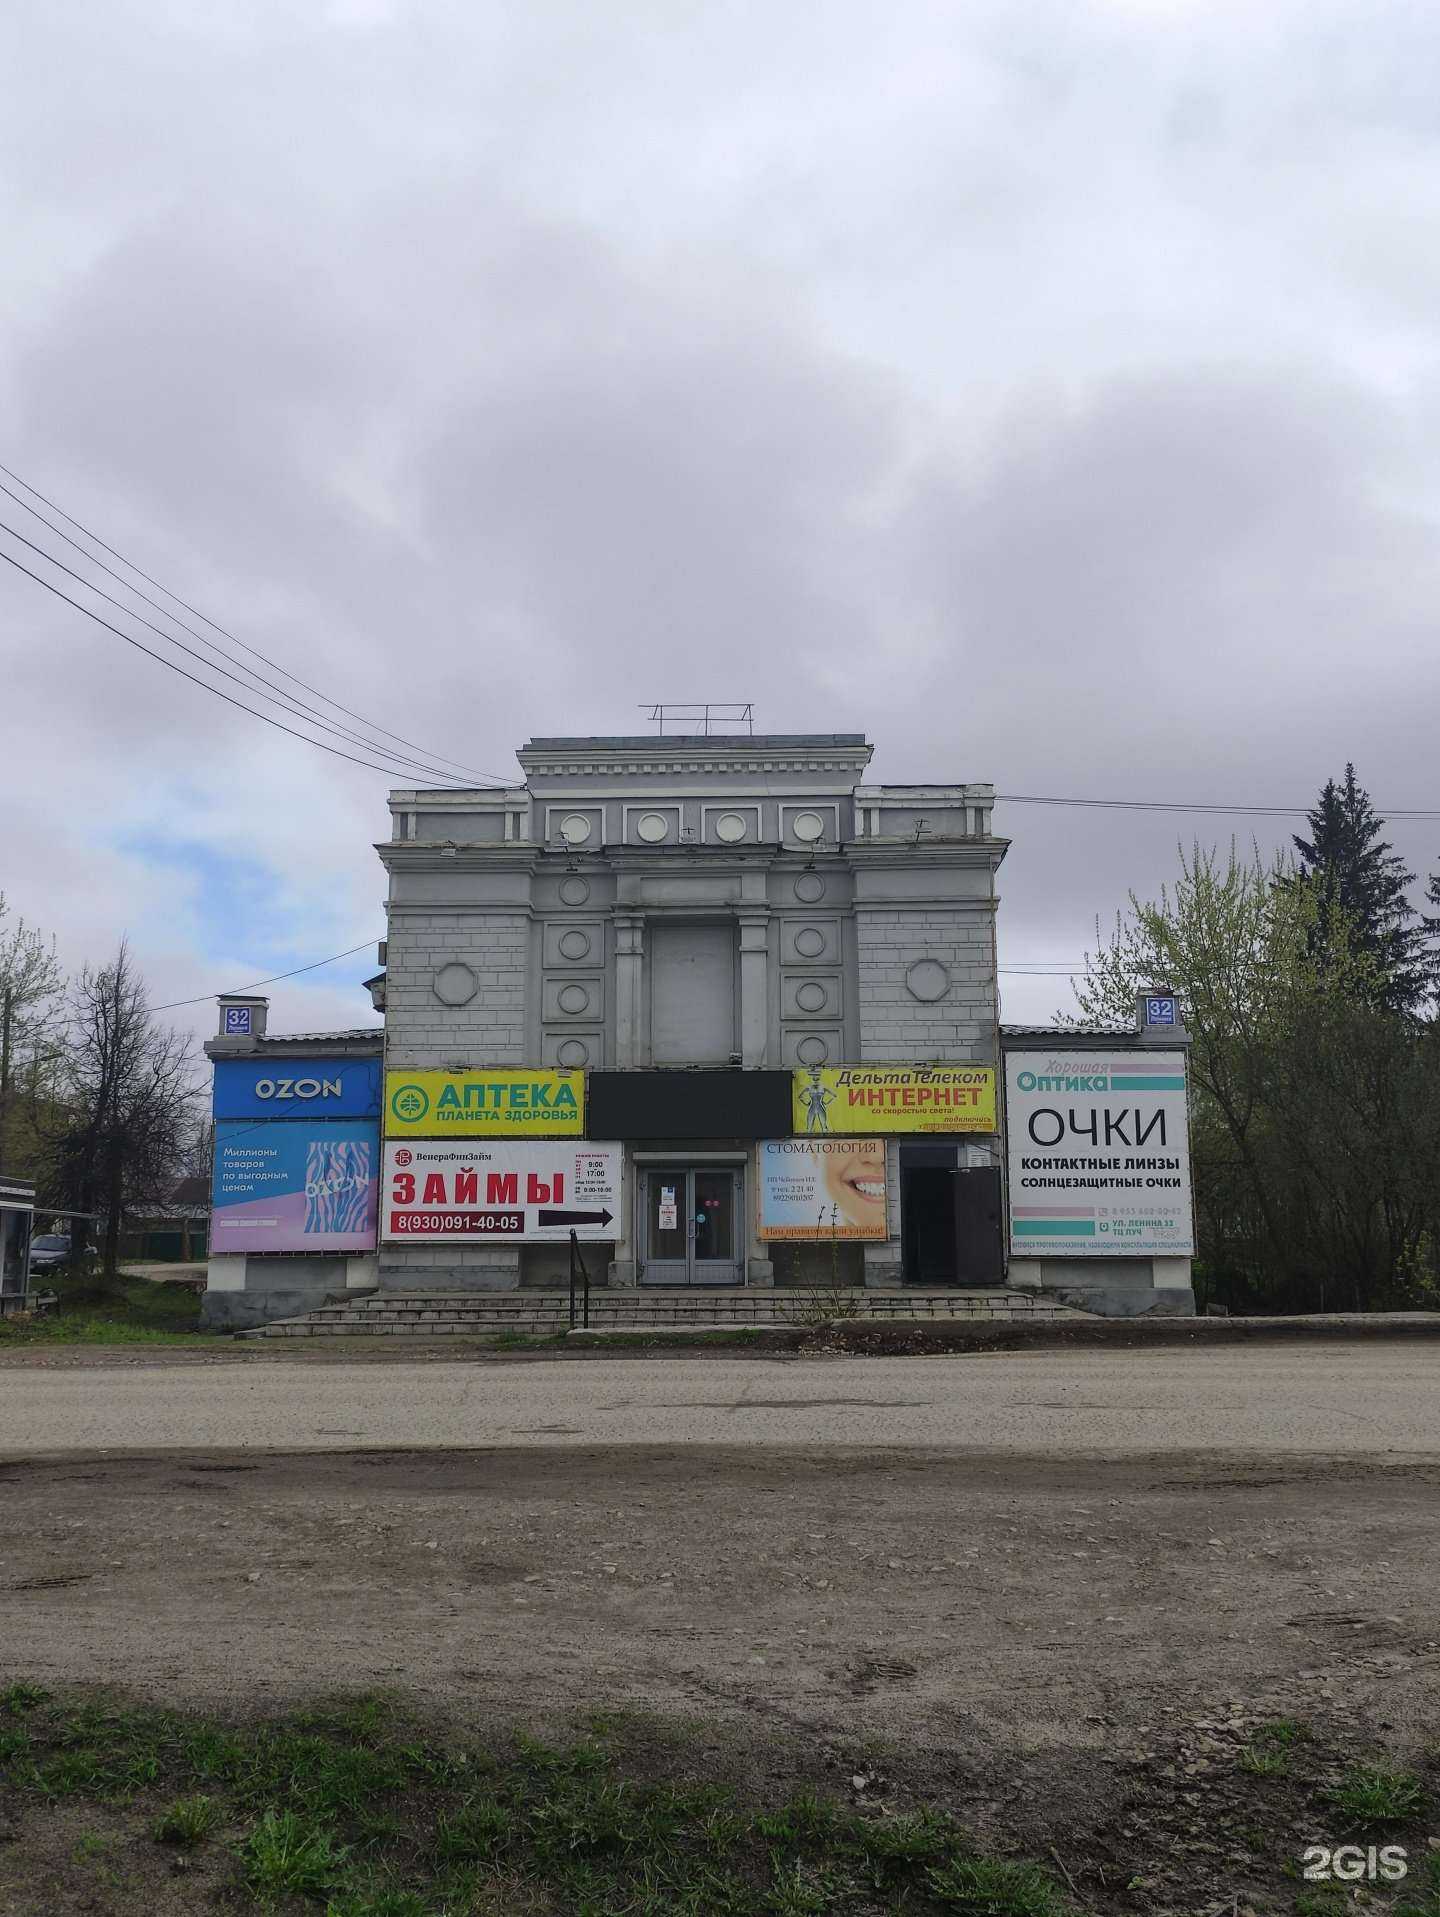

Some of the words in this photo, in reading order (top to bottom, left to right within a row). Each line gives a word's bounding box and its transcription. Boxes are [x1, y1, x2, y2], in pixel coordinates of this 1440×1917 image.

[1150, 1001, 1171, 1015] 32
[228, 1010, 249, 1025] 32
[1045, 1060, 1109, 1074] Хорошая
[255, 1079, 342, 1098] OZON
[1017, 1072, 1109, 1092] Оптика
[437, 1083, 577, 1108] АПТЕКА
[848, 1087, 982, 1106] ИНТЕРНЕТ
[436, 1111, 500, 1121] ПЛАНЕТА
[505, 1110, 578, 1122] ЗДОРОВЬЯ
[1028, 1108, 1167, 1147] ОЧКИ
[223, 1148, 278, 1157] Миллионы
[767, 1143, 876, 1154] СТОМАТОЛОГИЯ
[223, 1161, 265, 1169] товаров
[1021, 1158, 1121, 1170] КОНТАКТНЫЕ
[1124, 1158, 1180, 1170] ЛИНЗЫ
[238, 1172, 289, 1180] выгодным
[1021, 1177, 1143, 1189] СОЛНЦЕЗАЩИТНЫЕ
[1145, 1177, 1181, 1188] ОЧКИ
[222, 1184, 254, 1192] ценам
[392, 1167, 564, 1204] ЗАЙМЫ
[398, 1216, 518, 1231] 8(930)091-40-05
